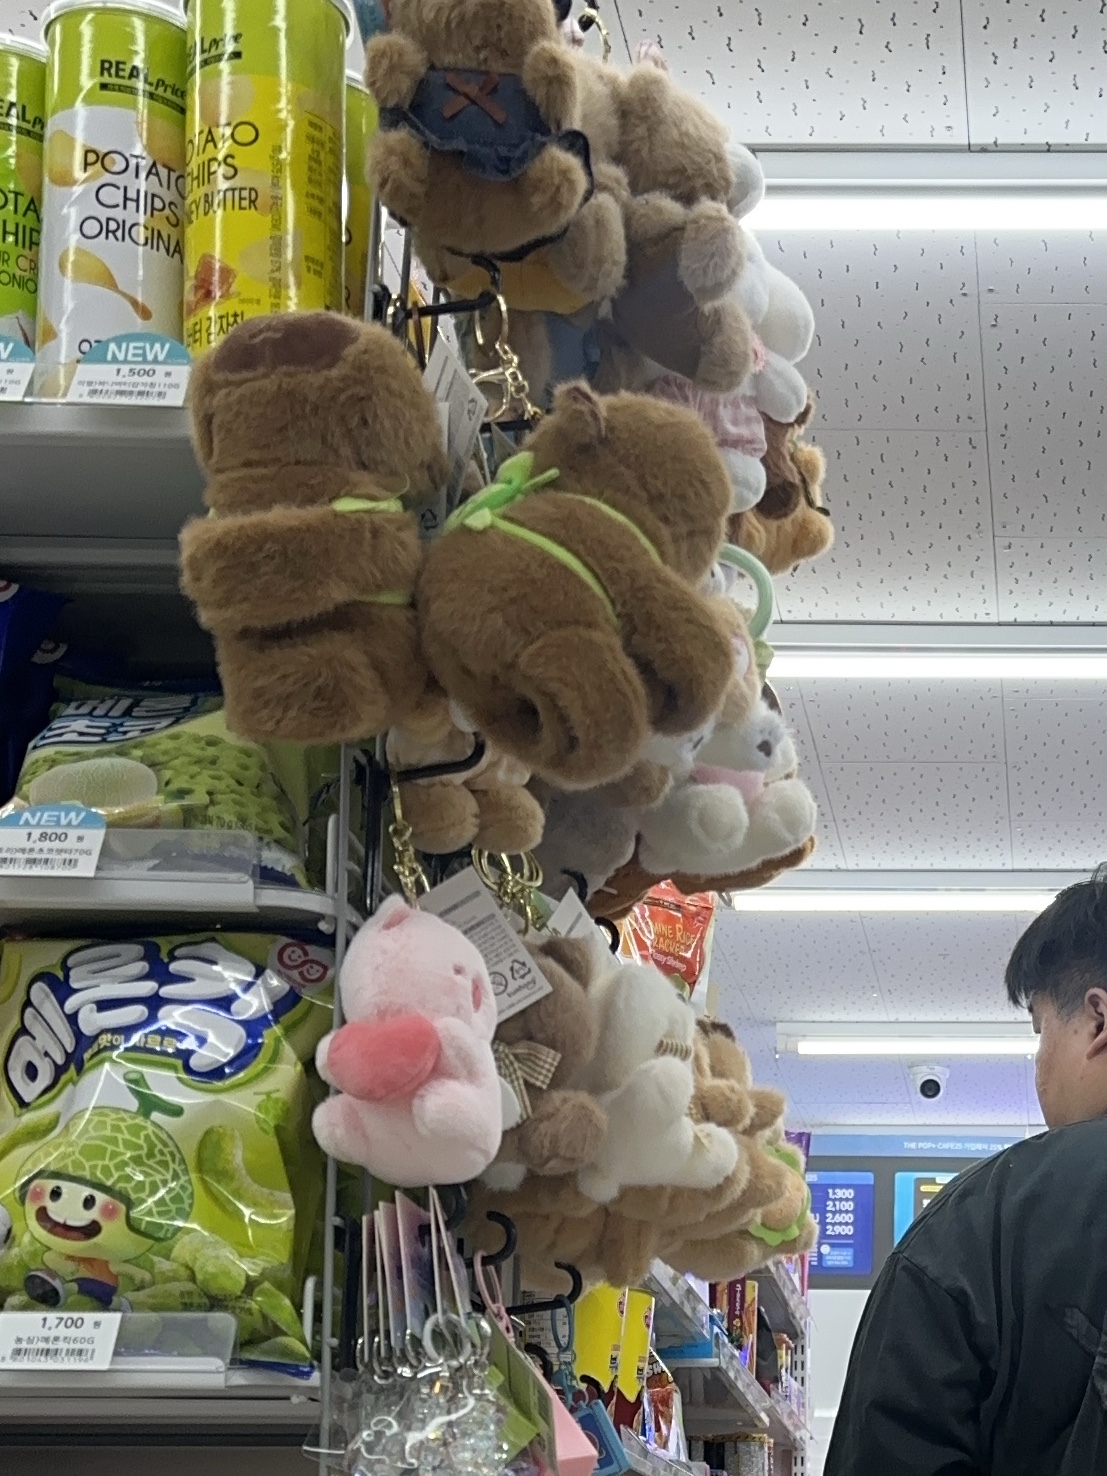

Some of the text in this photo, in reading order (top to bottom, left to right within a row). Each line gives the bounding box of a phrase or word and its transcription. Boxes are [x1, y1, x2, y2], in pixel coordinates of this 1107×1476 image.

[95, 183, 180, 228] CHIPS
[106, 343, 170, 361] NEW
[115, 368, 157, 378] 1,500
[19, 811, 86, 826] NEW
[26, 831, 68, 844] 1,800
[827, 1189, 854, 1199] 1,300
[826, 1201, 854, 1211] 2,100
[826, 1213, 854, 1223] 2,600
[826, 1225, 854, 1235] 2,900
[41, 1316, 85, 1330] 1,700
